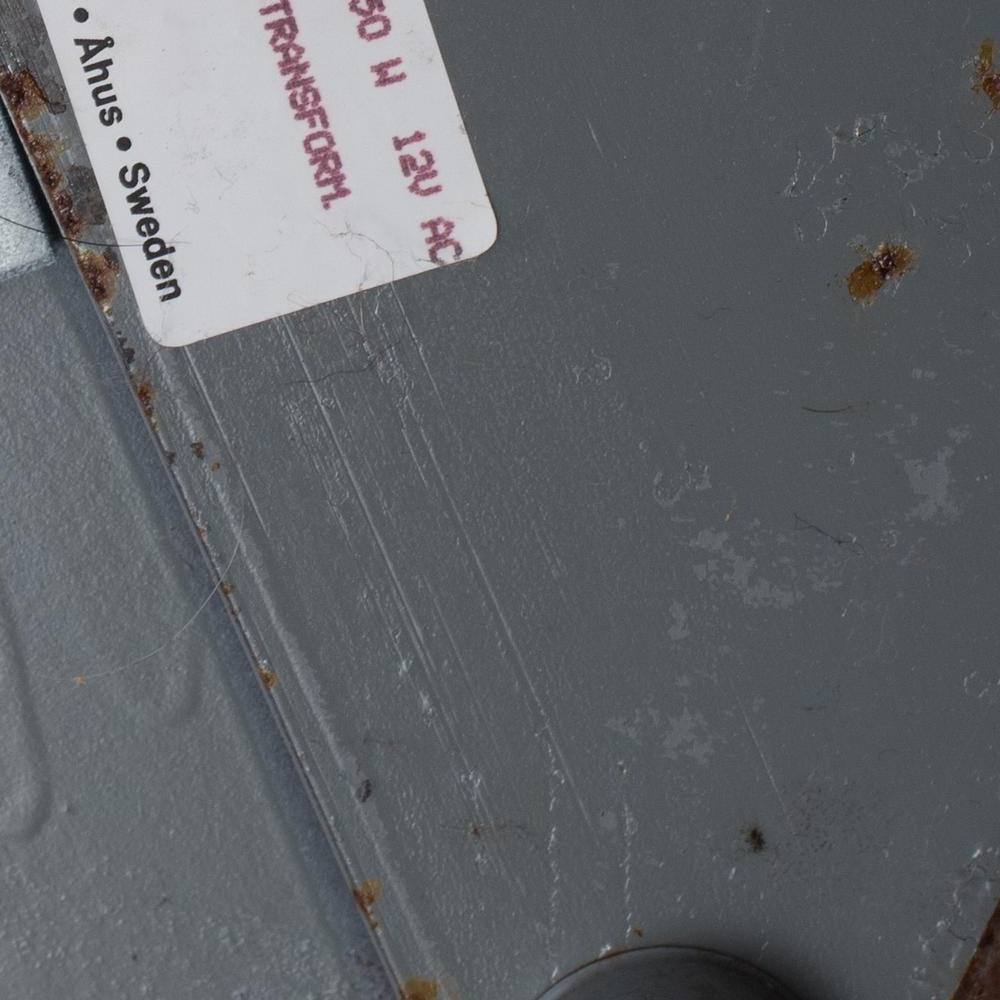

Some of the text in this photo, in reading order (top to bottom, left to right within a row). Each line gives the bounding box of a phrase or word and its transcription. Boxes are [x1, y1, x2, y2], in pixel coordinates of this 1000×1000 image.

[74, 36, 122, 126] Åhus
[119, 162, 181, 302] Sweden
[371, 57, 406, 87] W
[392, 131, 442, 196] 12V
[421, 217, 462, 265] AC
